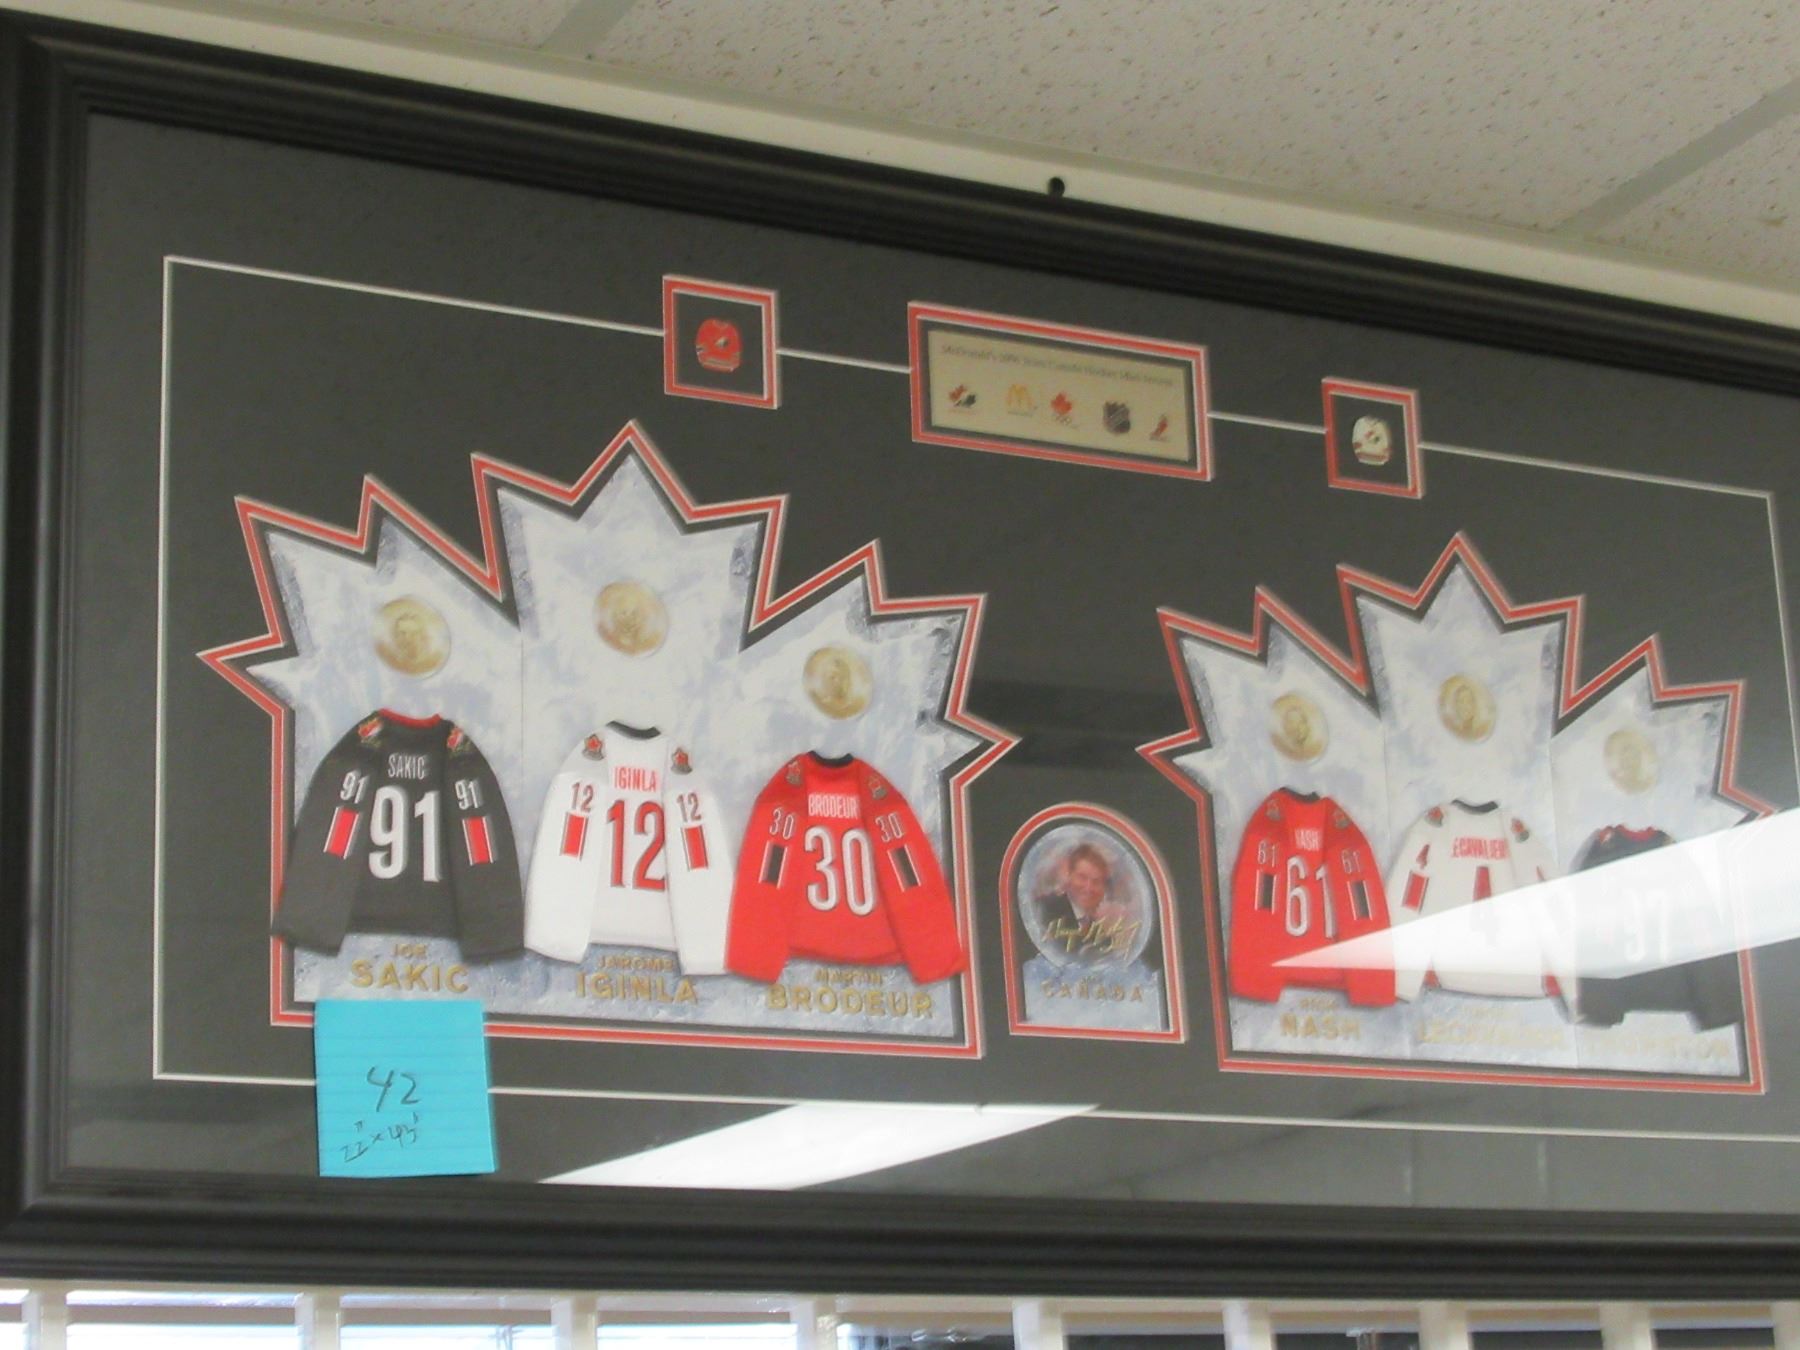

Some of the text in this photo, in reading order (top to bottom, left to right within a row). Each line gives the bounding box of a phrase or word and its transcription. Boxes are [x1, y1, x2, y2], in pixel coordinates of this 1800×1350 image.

[387, 754, 426, 780] SAKIC
[340, 770, 367, 805] 91
[455, 779, 480, 810] 91
[571, 781, 594, 813] 12
[676, 792, 703, 823] 12
[769, 806, 796, 840] 30
[369, 786, 441, 882] 91
[875, 811, 906, 841] 30
[606, 799, 666, 892] 12
[1257, 839, 1279, 868] 61
[1340, 848, 1361, 875] 61
[804, 825, 877, 917] 30
[1285, 855, 1338, 939] 61
[350, 959, 470, 993] SAKIC
[575, 970, 698, 1005] IGINLA
[766, 984, 934, 1019] BRODEUR
[1278, 1012, 1362, 1042] NASH
[365, 1065, 420, 1113] 42
